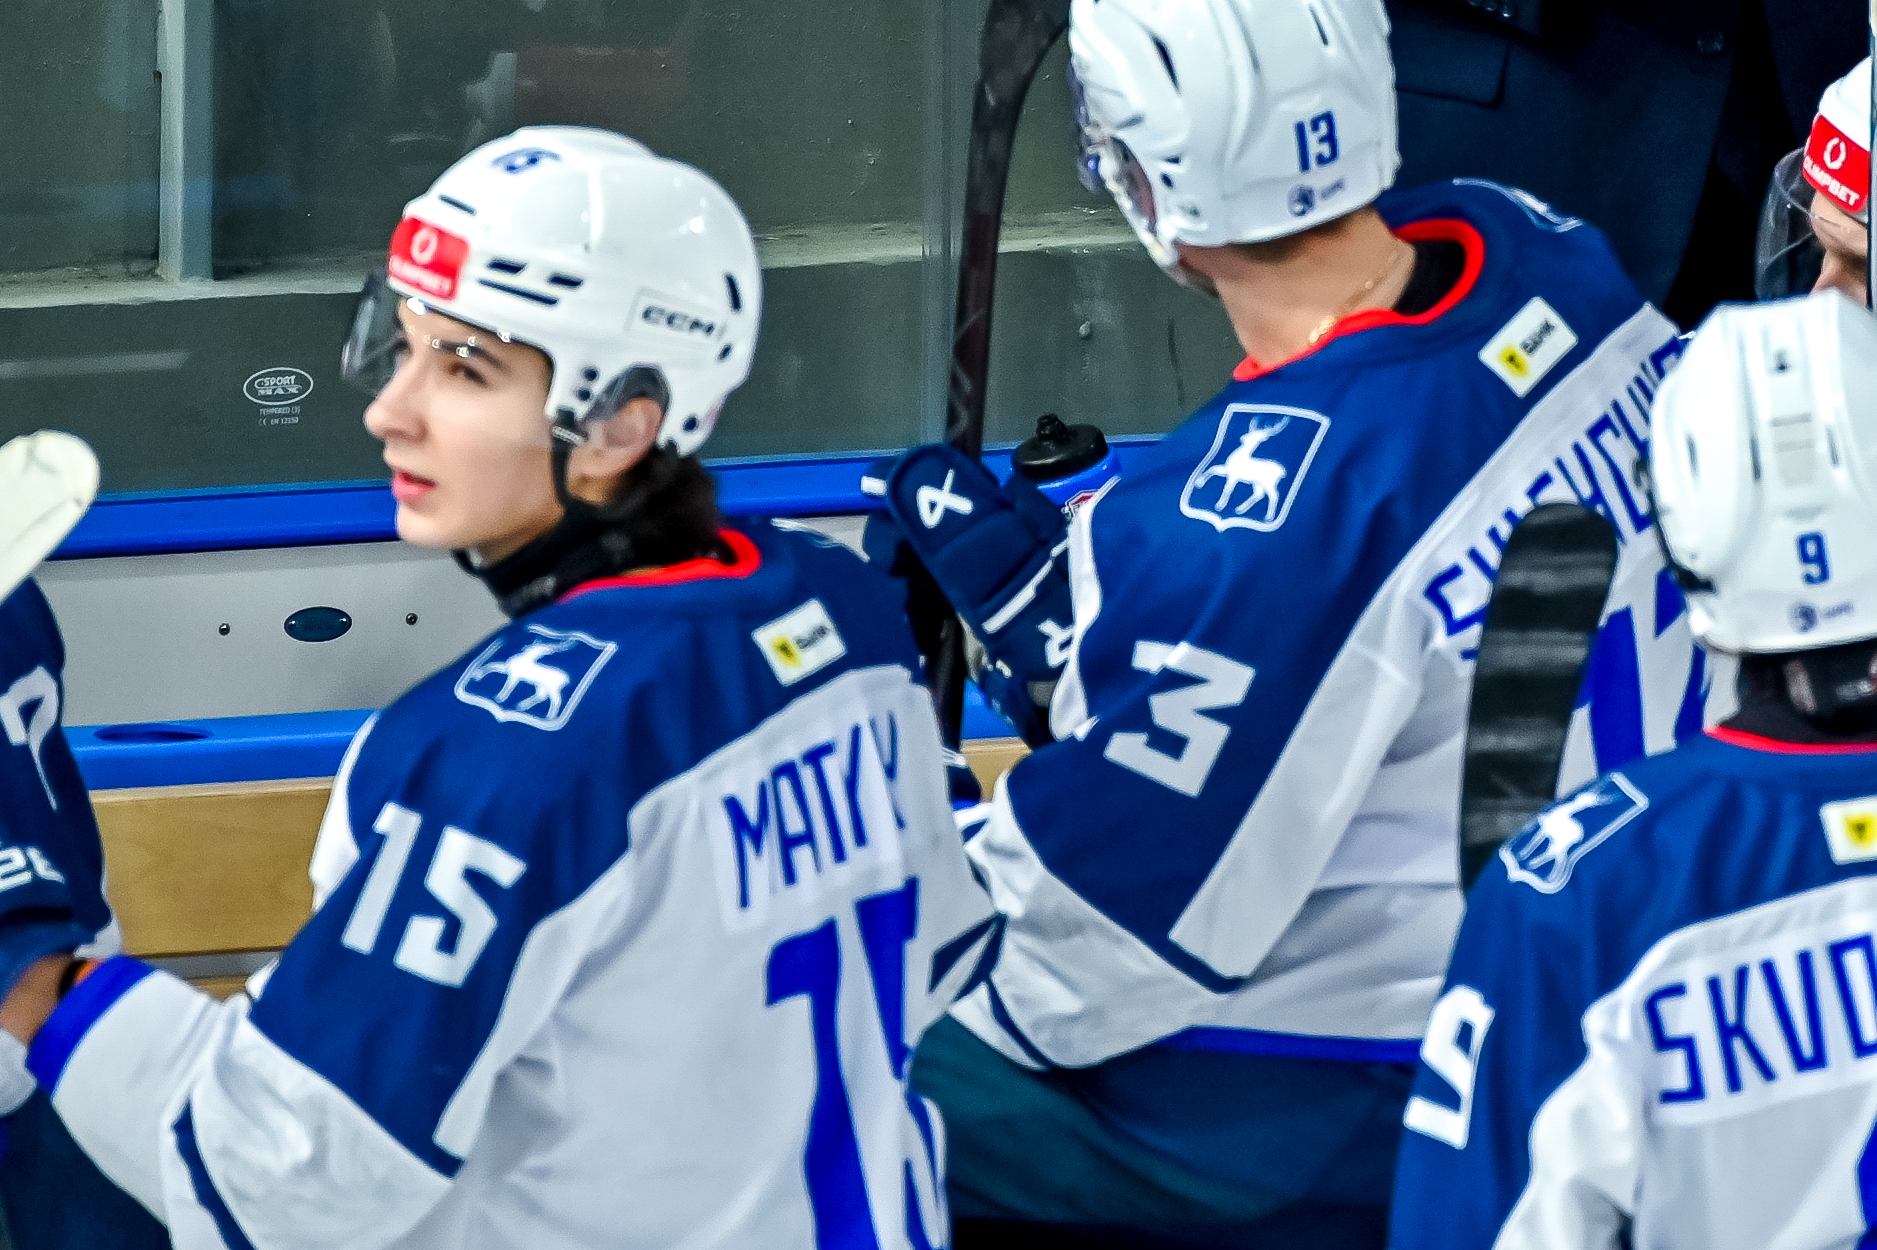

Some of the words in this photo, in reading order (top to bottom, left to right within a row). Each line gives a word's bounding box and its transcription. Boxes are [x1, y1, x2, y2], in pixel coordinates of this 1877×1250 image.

[1295, 110, 1338, 173] 13
[1797, 530, 1829, 584] 9
[341, 801, 527, 988] 15
